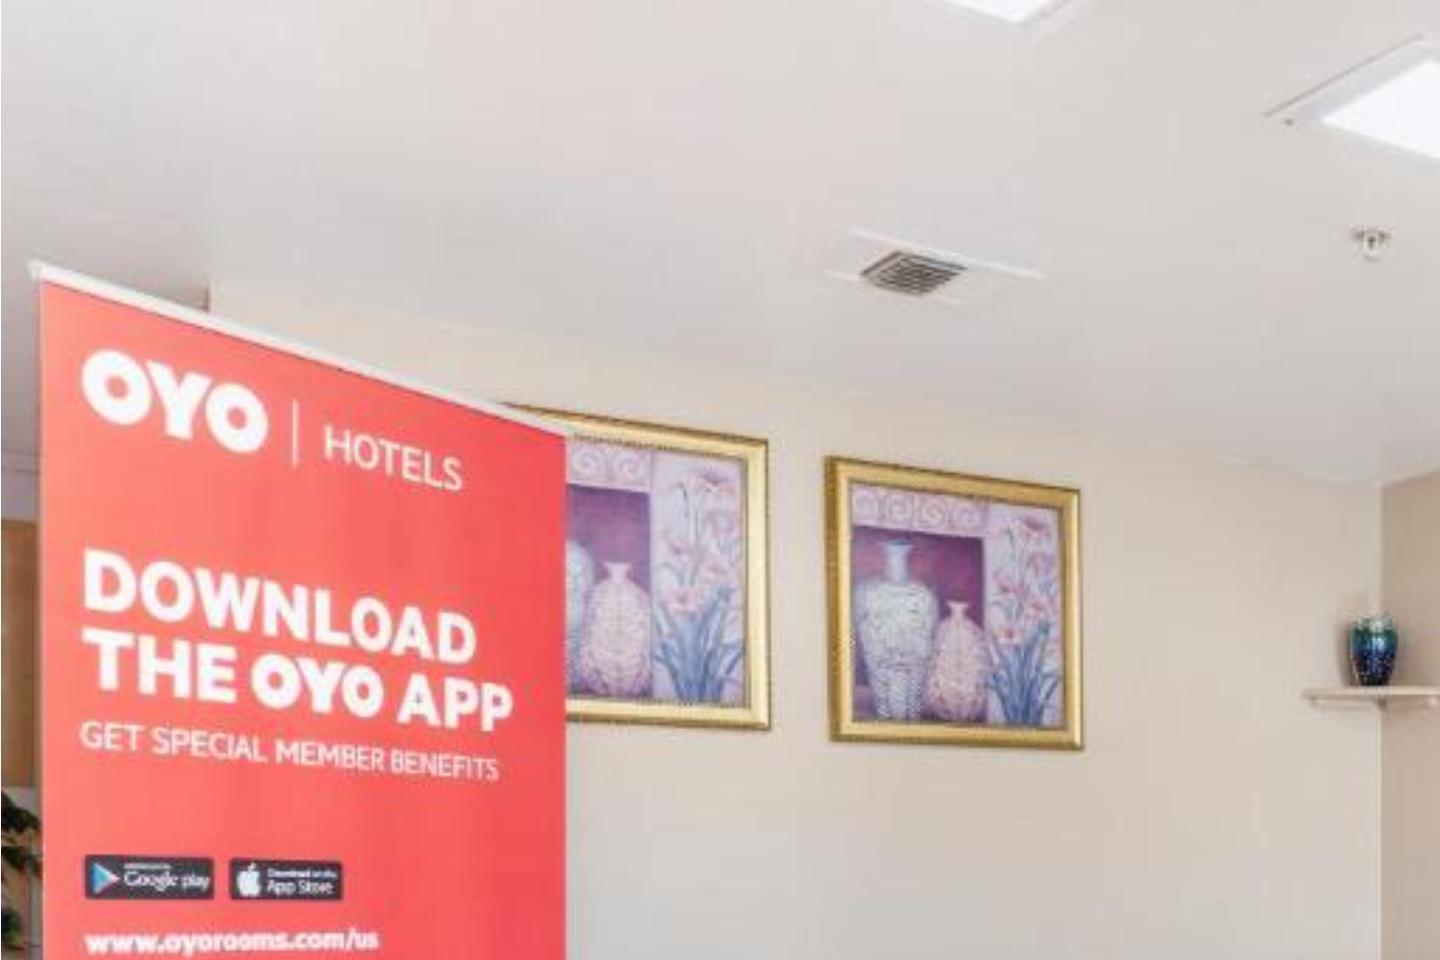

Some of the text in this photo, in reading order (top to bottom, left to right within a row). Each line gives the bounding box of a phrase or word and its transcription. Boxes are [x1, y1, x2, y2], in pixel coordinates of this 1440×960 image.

[81, 349, 463, 491] OYO HOTELS
[82, 546, 477, 664] DOWNLOAD
[80, 627, 513, 733] THE OYO APP
[79, 720, 499, 782] GET SPECIAL MEMBER BENEFITS
[123, 870, 178, 891] Google
[266, 878, 334, 895] App Store
[83, 928, 379, 957] www.oyorooms.com/us
